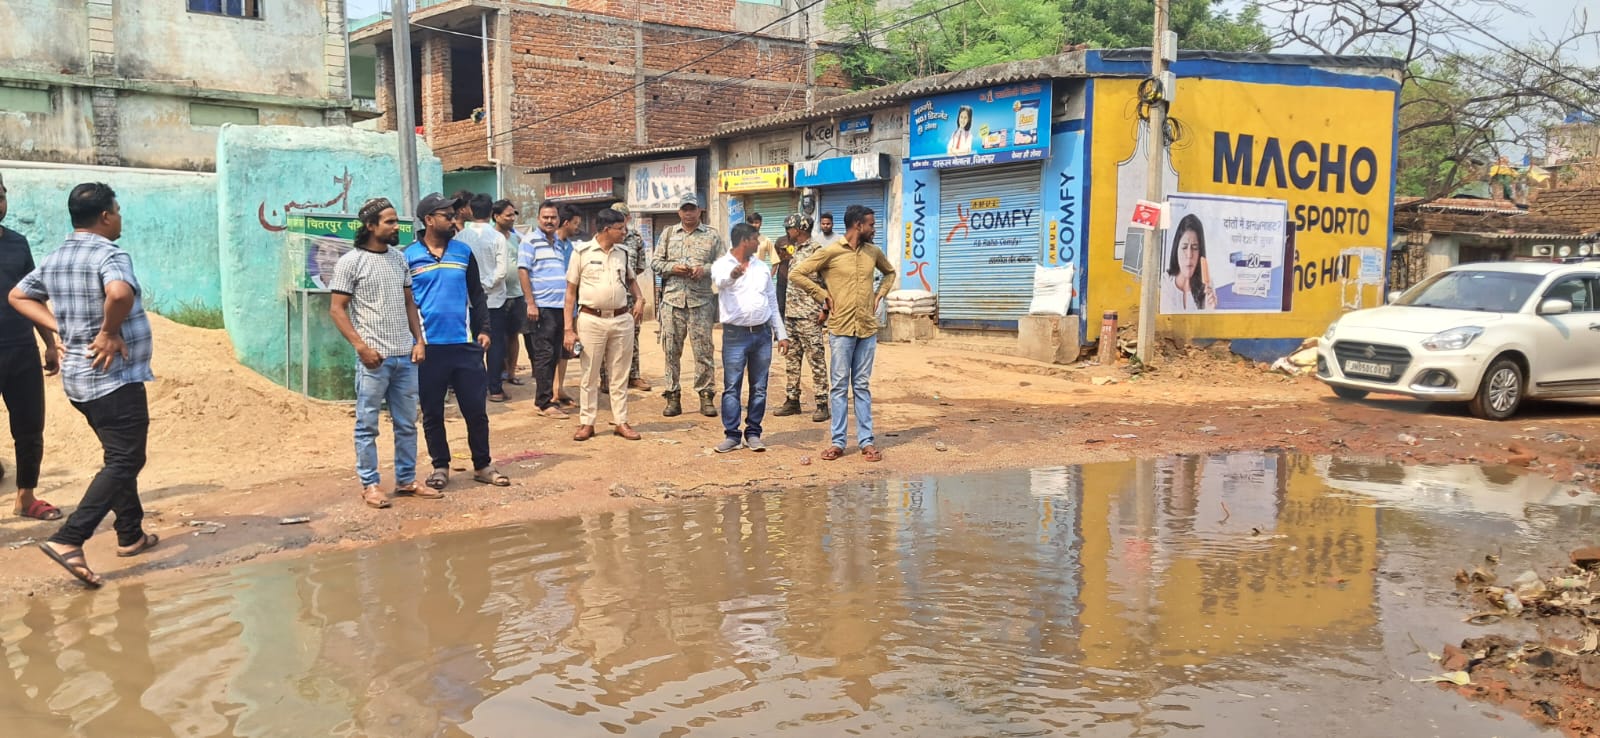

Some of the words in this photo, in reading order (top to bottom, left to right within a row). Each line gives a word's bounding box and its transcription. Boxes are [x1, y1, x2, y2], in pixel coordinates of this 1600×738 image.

[760, 166, 781, 174] TAILOR
[1213, 131, 1378, 195] MACHO
[913, 179, 926, 259] COMFY
[971, 208, 1034, 230] COMFY
[1059, 172, 1075, 262] COMFY
[1294, 204, 1370, 235] SPORTO
